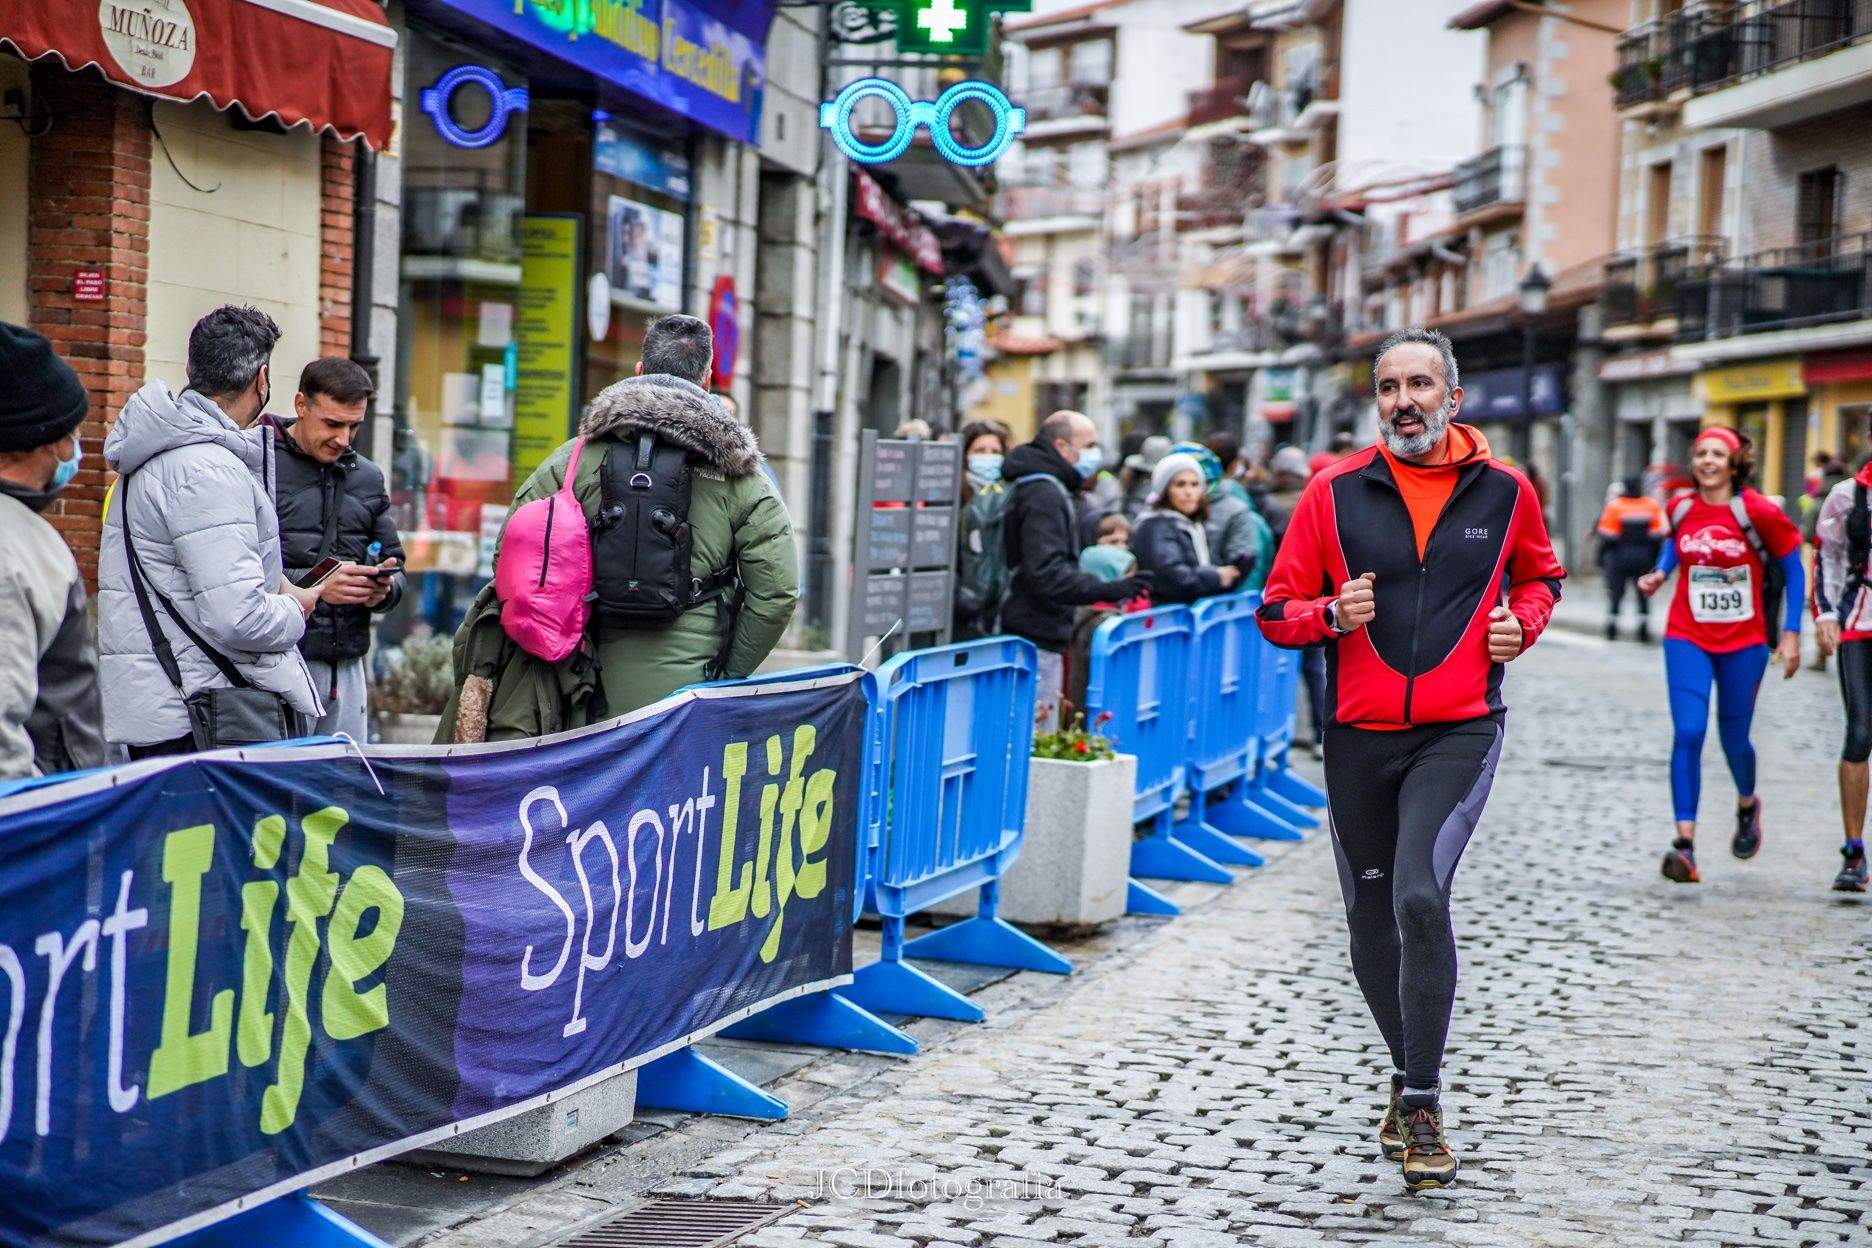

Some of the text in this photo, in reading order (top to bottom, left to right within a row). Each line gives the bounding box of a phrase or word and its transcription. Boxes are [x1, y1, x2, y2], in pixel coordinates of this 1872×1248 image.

[106, 5, 189, 51] MUÑOZA
[141, 65, 156, 78] BAR
[1700, 590, 1742, 610] 1359
